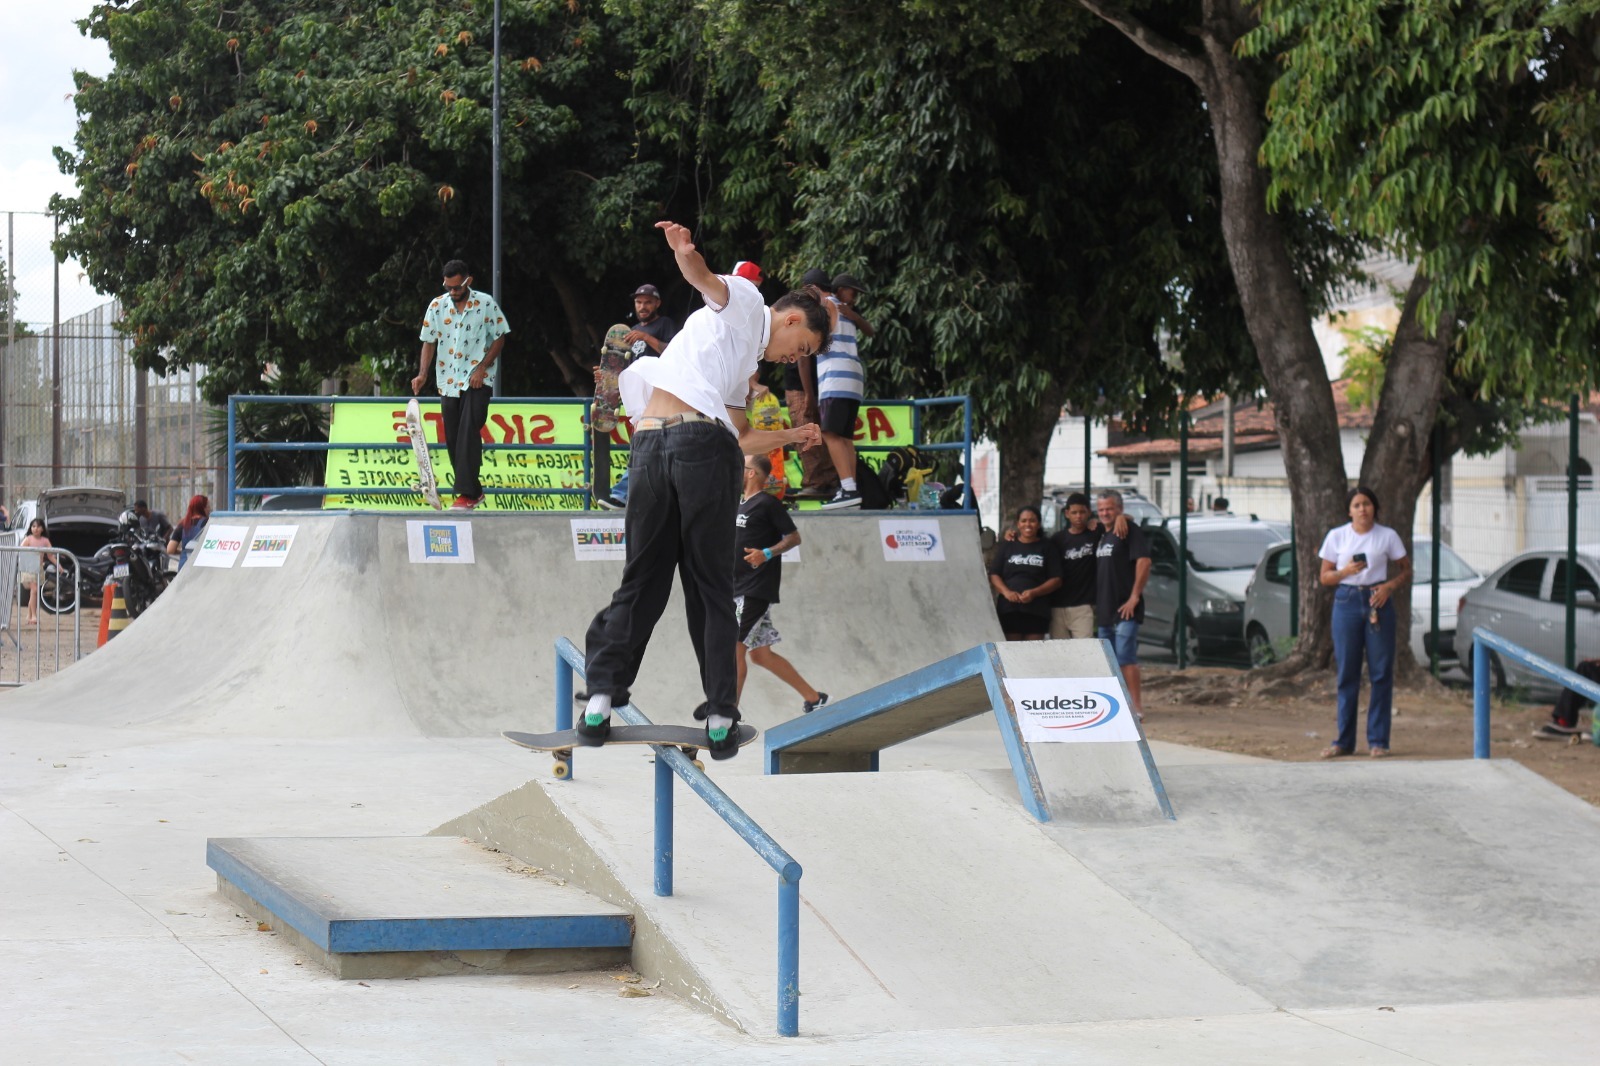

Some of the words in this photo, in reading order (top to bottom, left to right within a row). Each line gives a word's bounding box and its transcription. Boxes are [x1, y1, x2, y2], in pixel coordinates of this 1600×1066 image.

[216, 541, 241, 551] NETO
[251, 540, 288, 551] BAHIA
[1020, 695, 1097, 711] sudesb
